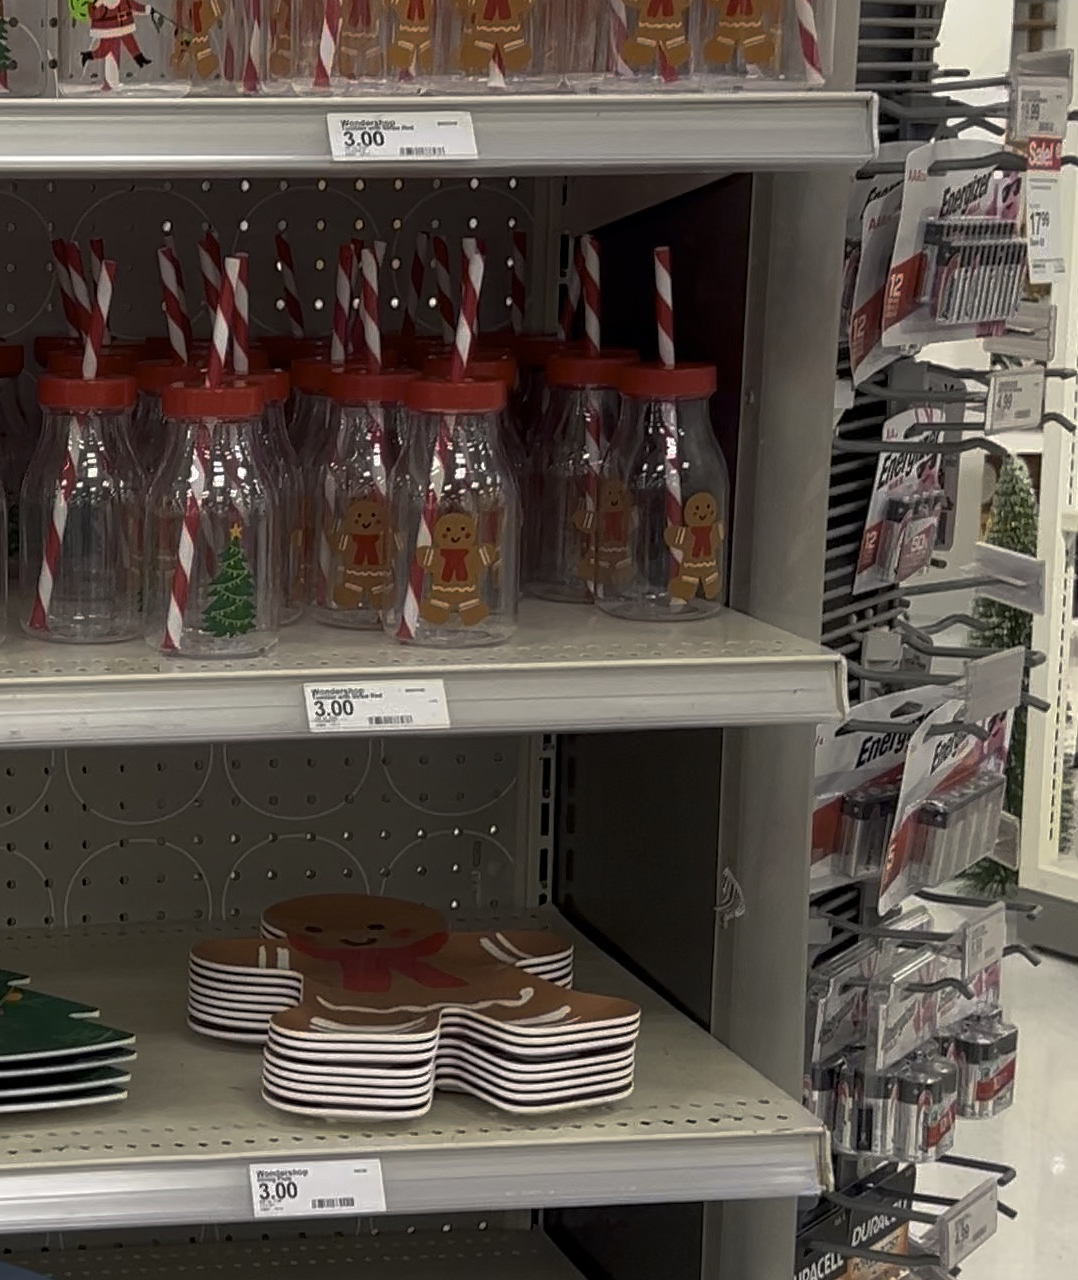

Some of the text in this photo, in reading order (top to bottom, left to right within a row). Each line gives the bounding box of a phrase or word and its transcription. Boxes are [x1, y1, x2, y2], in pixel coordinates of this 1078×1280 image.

[343, 131, 385, 147] 3.00
[938, 170, 993, 219] Energizer
[890, 272, 904, 297] 12
[853, 314, 867, 339] 12
[314, 700, 354, 716] 3.00
[259, 1181, 298, 1200] 3.00
